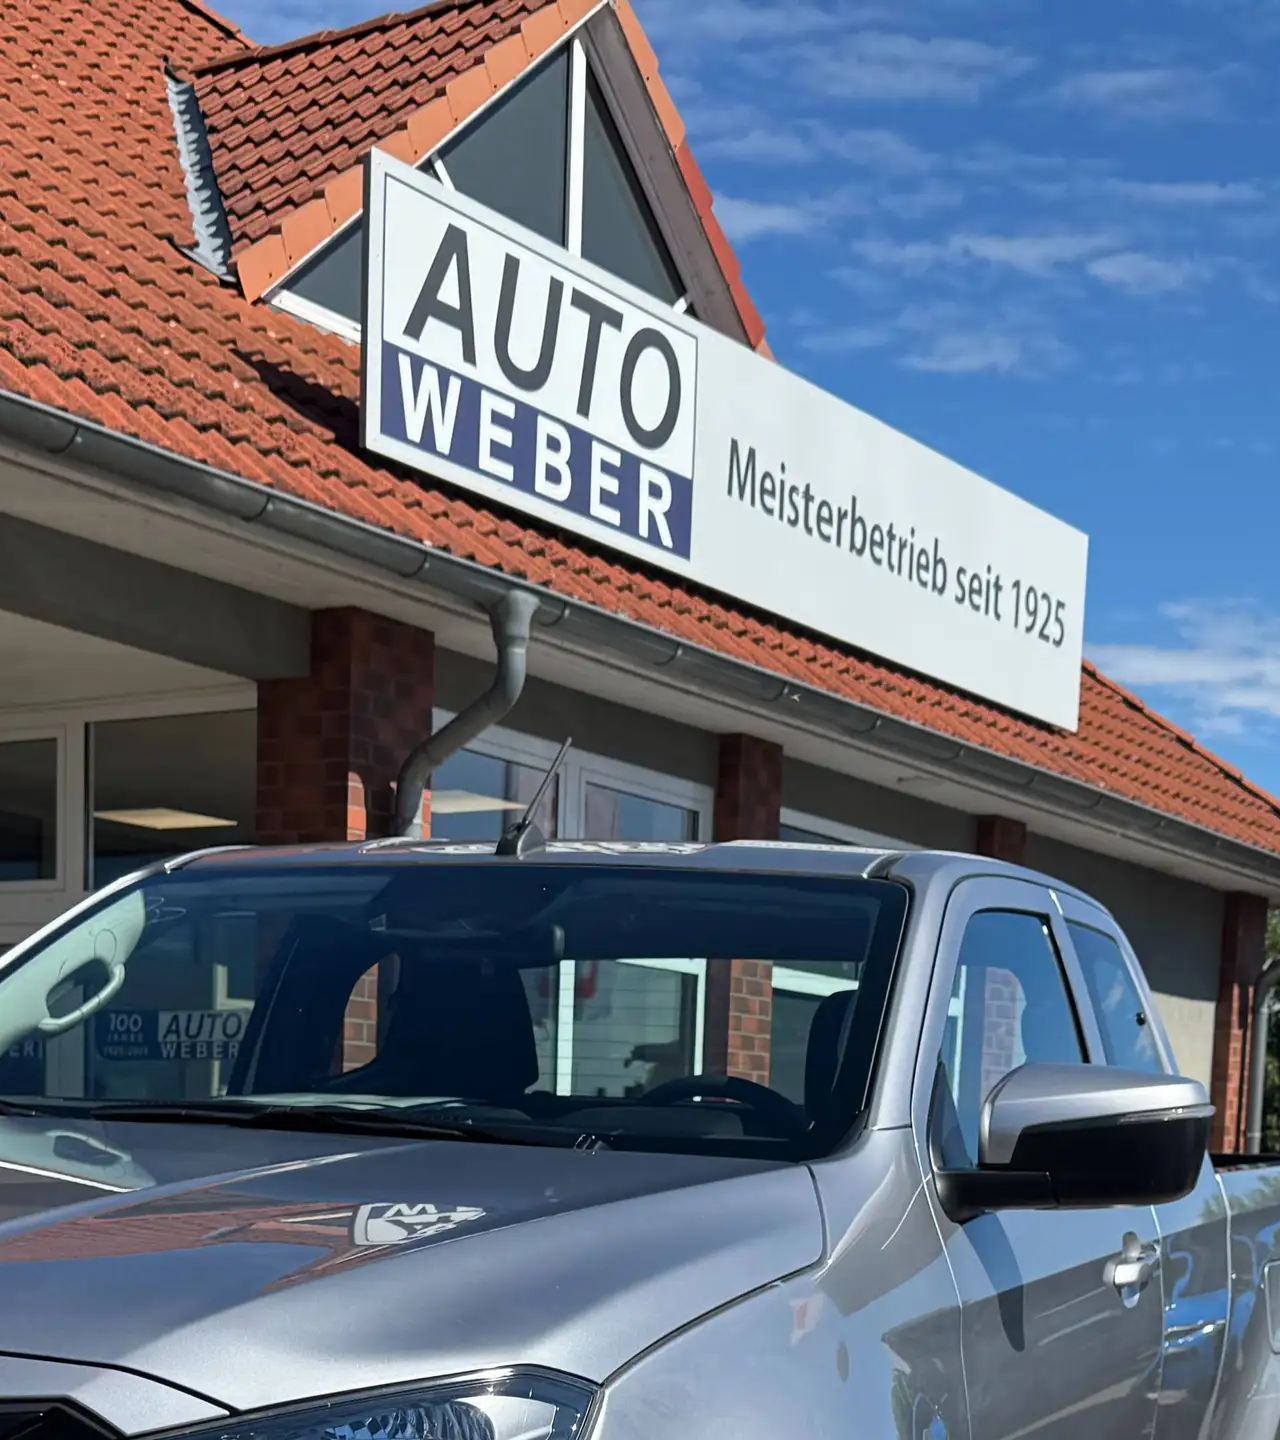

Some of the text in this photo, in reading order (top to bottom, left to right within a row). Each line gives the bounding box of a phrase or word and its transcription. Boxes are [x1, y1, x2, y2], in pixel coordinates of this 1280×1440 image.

[403, 223, 682, 450] AUTO
[397, 352, 674, 550] WEBER
[726, 436, 1066, 649] Meisterbetrieb seit 1925
[108, 1012, 143, 1033] 100
[160, 1041, 240, 1060] WEBER
[162, 1012, 242, 1040] AUTO
